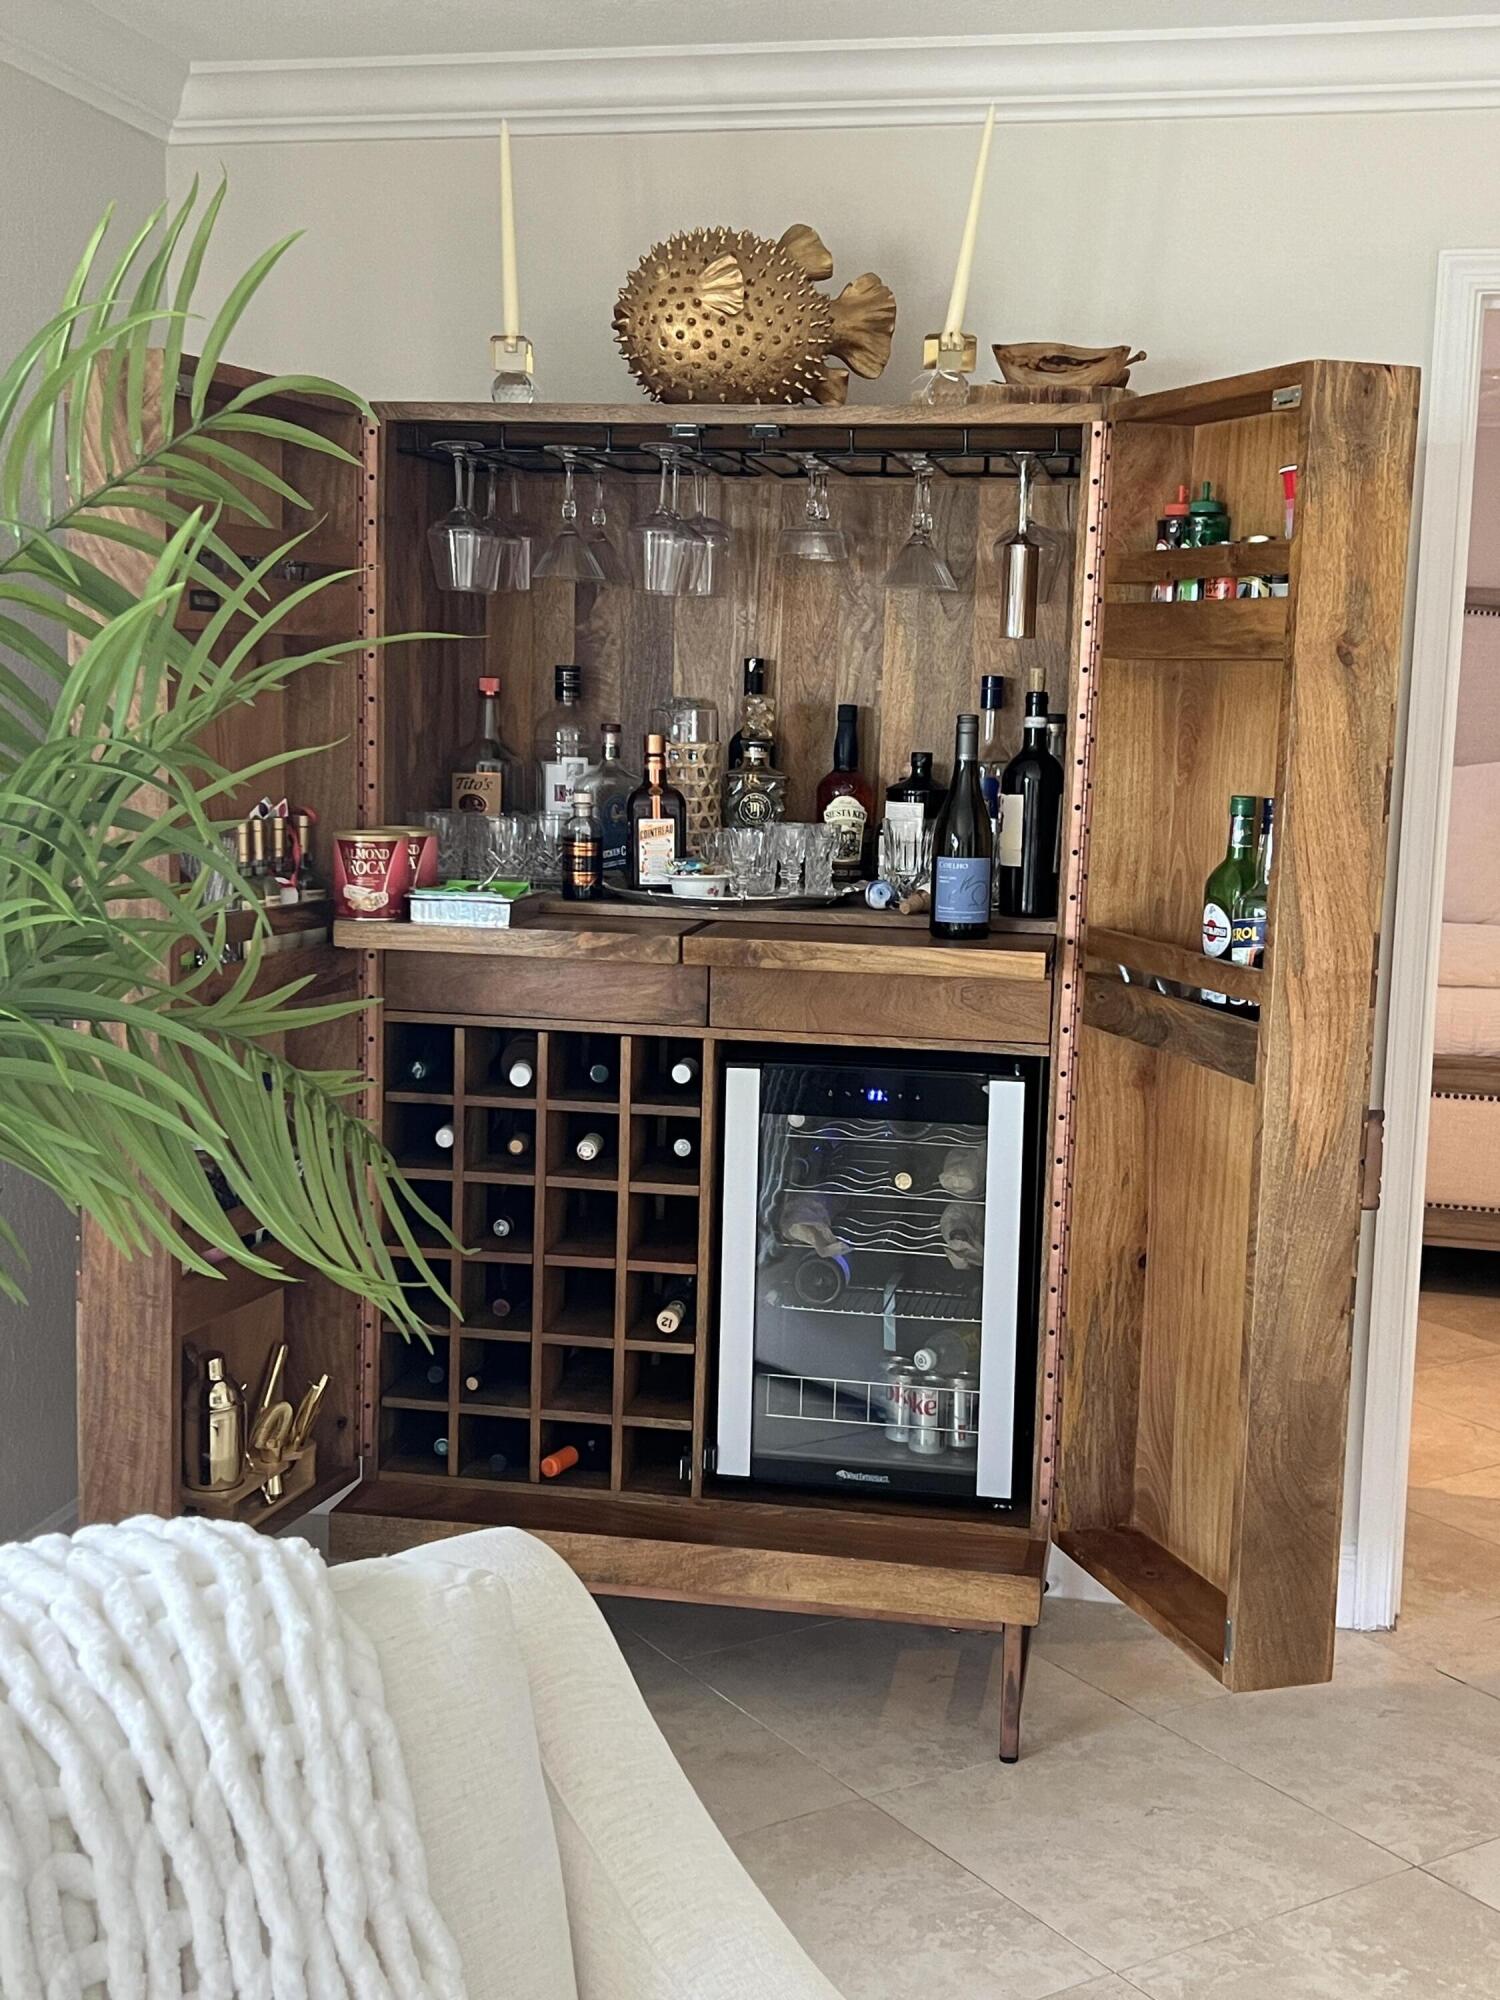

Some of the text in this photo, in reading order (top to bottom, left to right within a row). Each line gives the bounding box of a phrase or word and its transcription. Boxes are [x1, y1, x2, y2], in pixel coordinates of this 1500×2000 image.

[456, 777, 493, 790] Tito's
[825, 809, 851, 819] SIESTA
[640, 824, 673, 841] COINTREAU
[348, 860, 386, 876] ROCA
[1232, 926, 1260, 942] EROL
